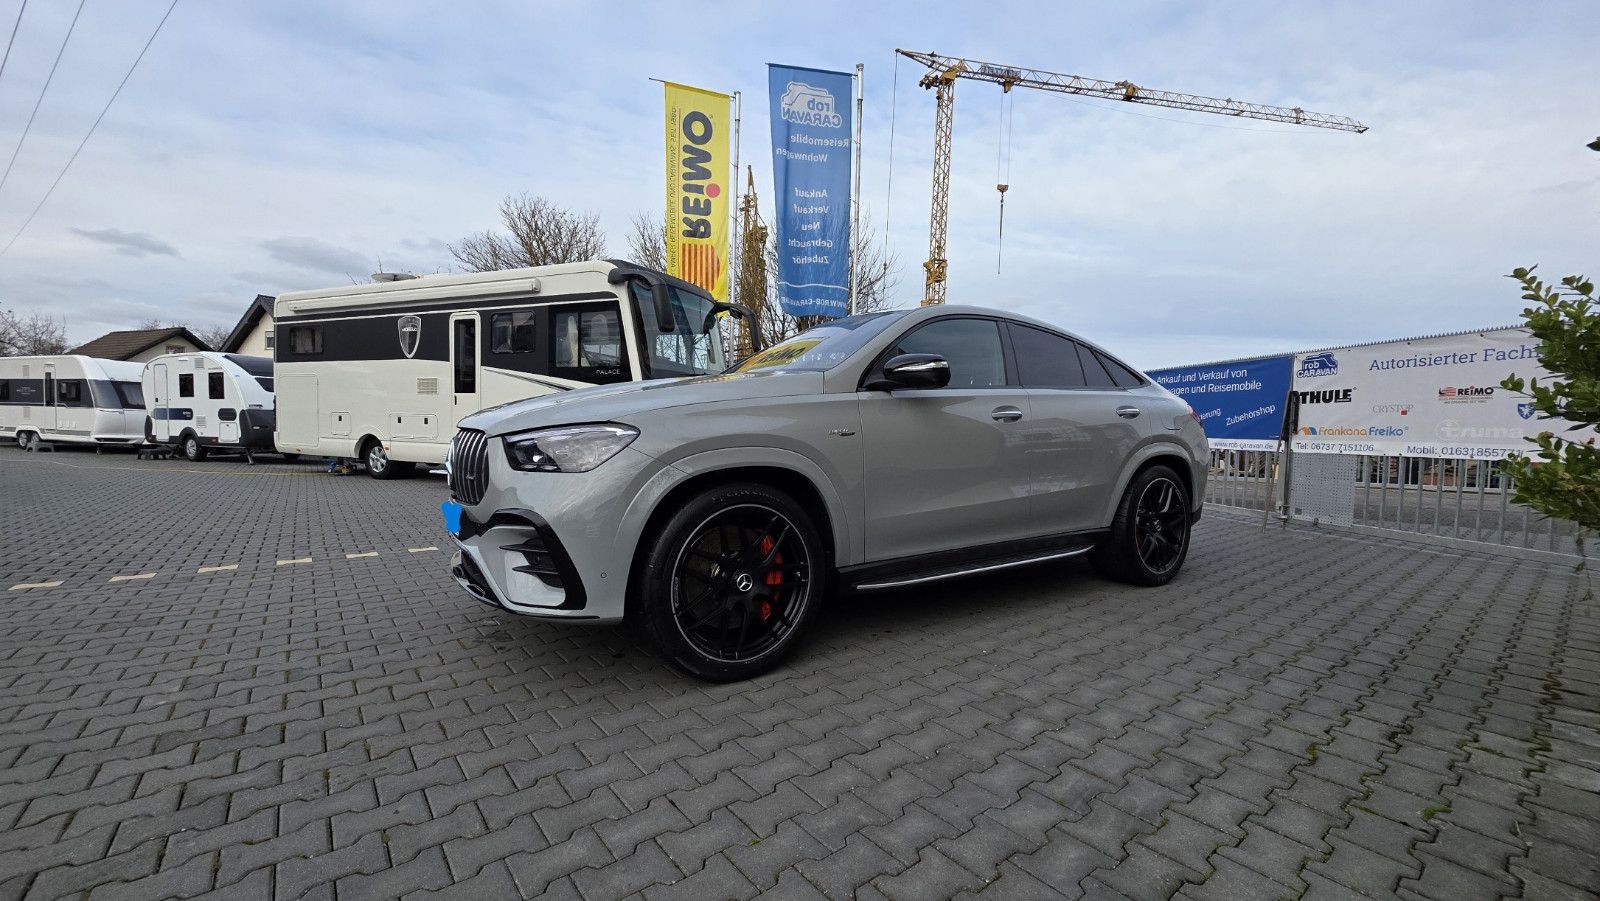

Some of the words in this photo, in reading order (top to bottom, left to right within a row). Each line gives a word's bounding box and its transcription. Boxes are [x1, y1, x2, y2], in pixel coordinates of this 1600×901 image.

[1304, 360, 1319, 370] rob
[1369, 352, 1478, 371] Autorisierter
[1156, 373, 1181, 384] Ankauf
[1182, 372, 1196, 382] und
[1198, 369, 1229, 381] Verkauf
[1231, 369, 1247, 378] von
[1296, 367, 1338, 378] CARAVAN
[1191, 383, 1206, 394] und
[1207, 380, 1262, 393] Reisemobile
[1299, 388, 1352, 404] THULE
[1226, 404, 1276, 426] Zubehörshop
[1318, 426, 1367, 436] Frankona
[1368, 426, 1404, 436] Freiko
[1296, 442, 1309, 450] Tel:
[1311, 443, 1336, 451] 06737
[1338, 444, 1375, 452] 7151106
[1406, 445, 1438, 455] Mobil:
